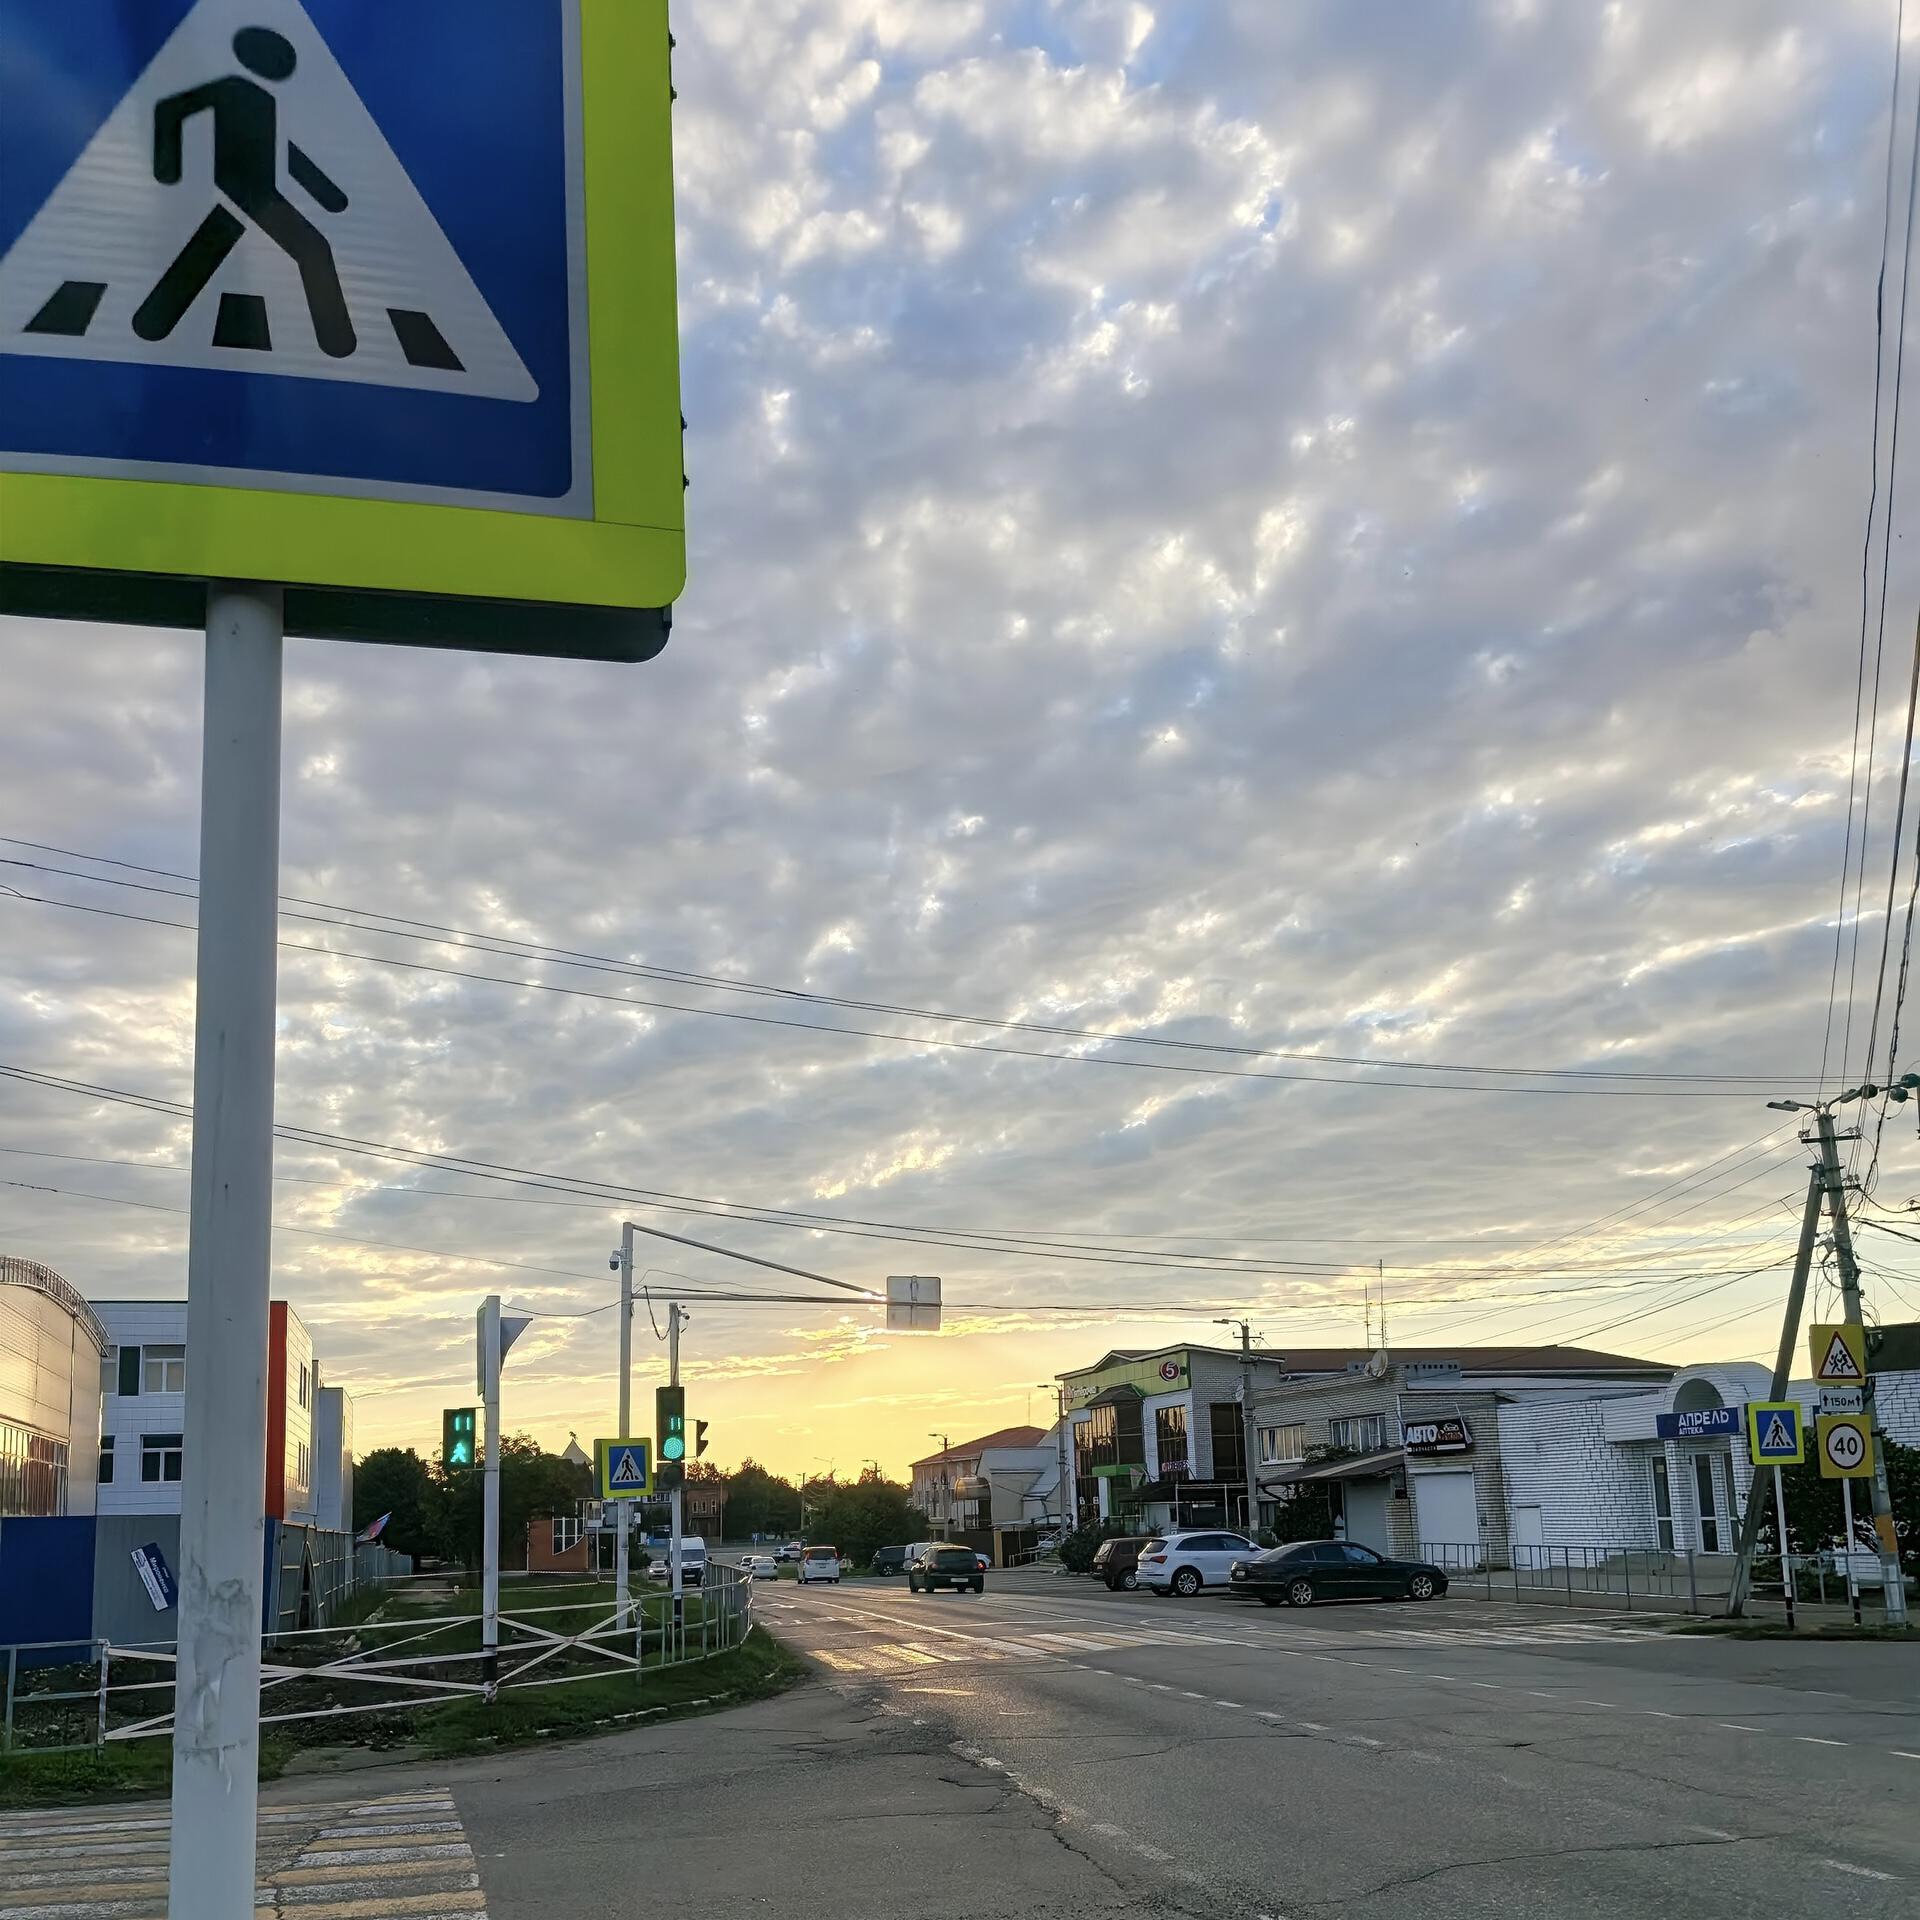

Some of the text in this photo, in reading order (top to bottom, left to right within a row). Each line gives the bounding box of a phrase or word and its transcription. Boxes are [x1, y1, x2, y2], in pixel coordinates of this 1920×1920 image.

[1165, 1361, 1176, 1378] 5
[1678, 1410, 1729, 1427] АПРЕЛЬ
[1405, 1424, 1439, 1444] АВТО
[1679, 1426, 1704, 1435] АПТЕКА
[1834, 1436, 1858, 1456] 40
